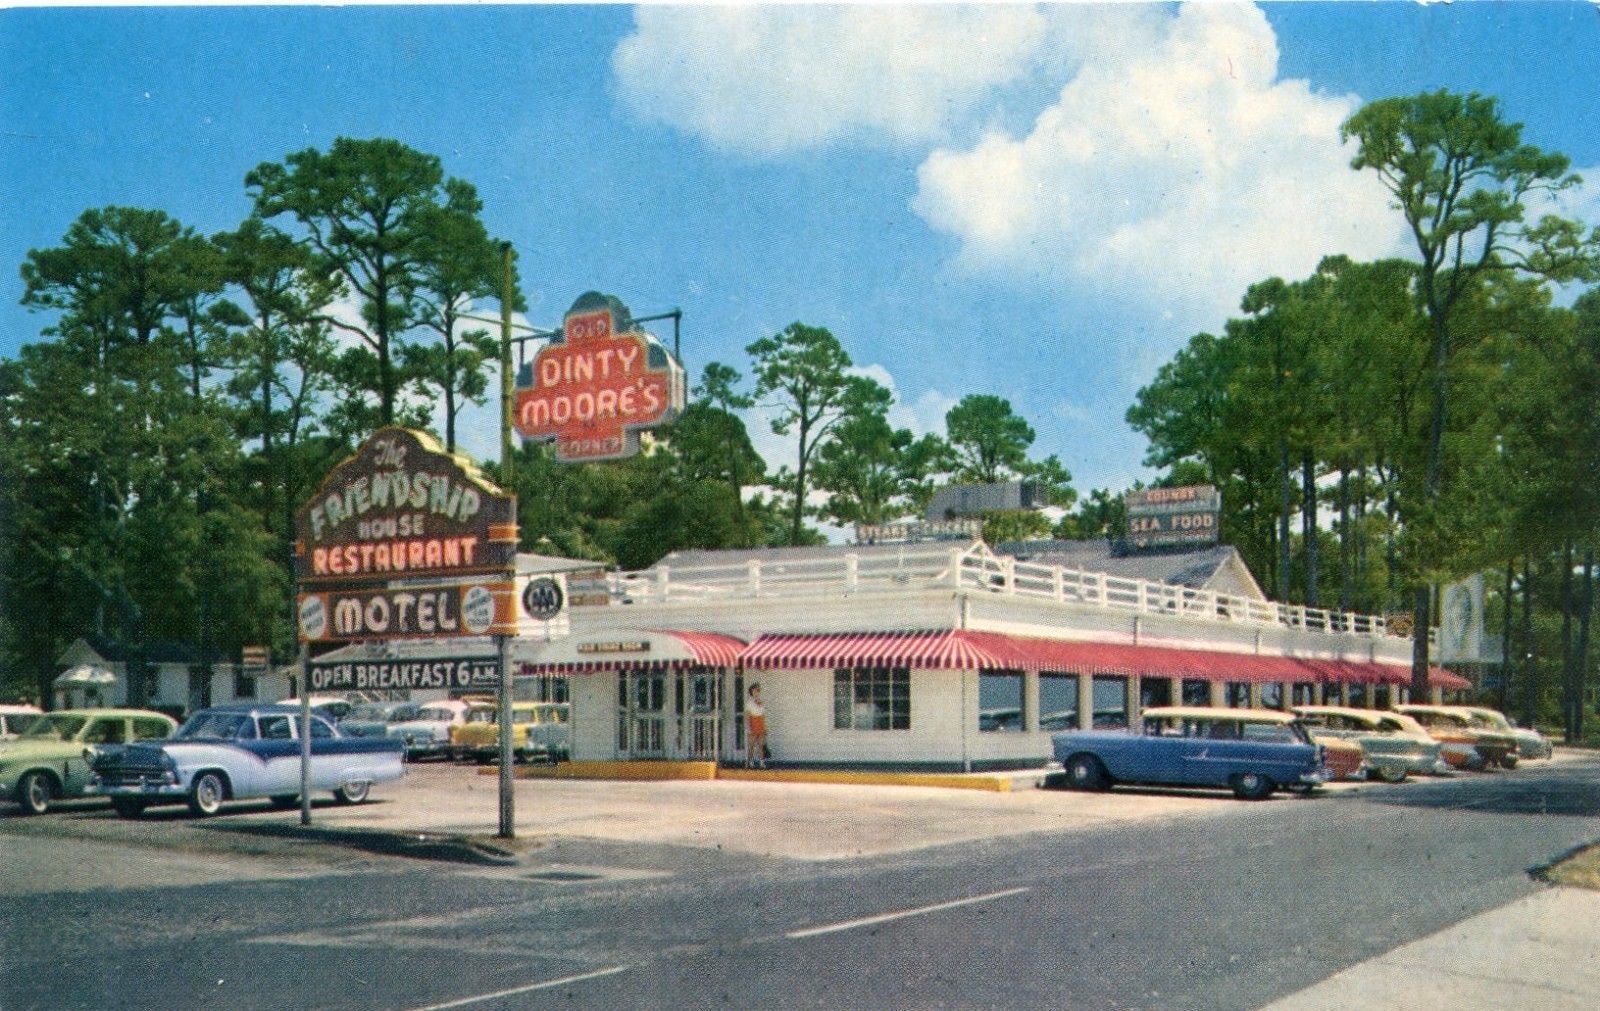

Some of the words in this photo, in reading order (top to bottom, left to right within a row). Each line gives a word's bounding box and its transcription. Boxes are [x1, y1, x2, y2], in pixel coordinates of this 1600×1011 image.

[541, 346, 639, 388] DINTY
[521, 377, 661, 428] MOORE'S
[373, 439, 407, 468] The
[309, 470, 481, 540] FRIENDSHIP
[1130, 516, 1161, 533] SEA
[1172, 513, 1214, 531] FOOD
[358, 513, 425, 539] HOUSE
[312, 537, 477, 574] RESTAURANT
[334, 593, 457, 634] MOTEL
[311, 666, 351, 688] OPEN
[357, 661, 453, 688] BREAKFAST
[457, 659, 471, 685] 6
